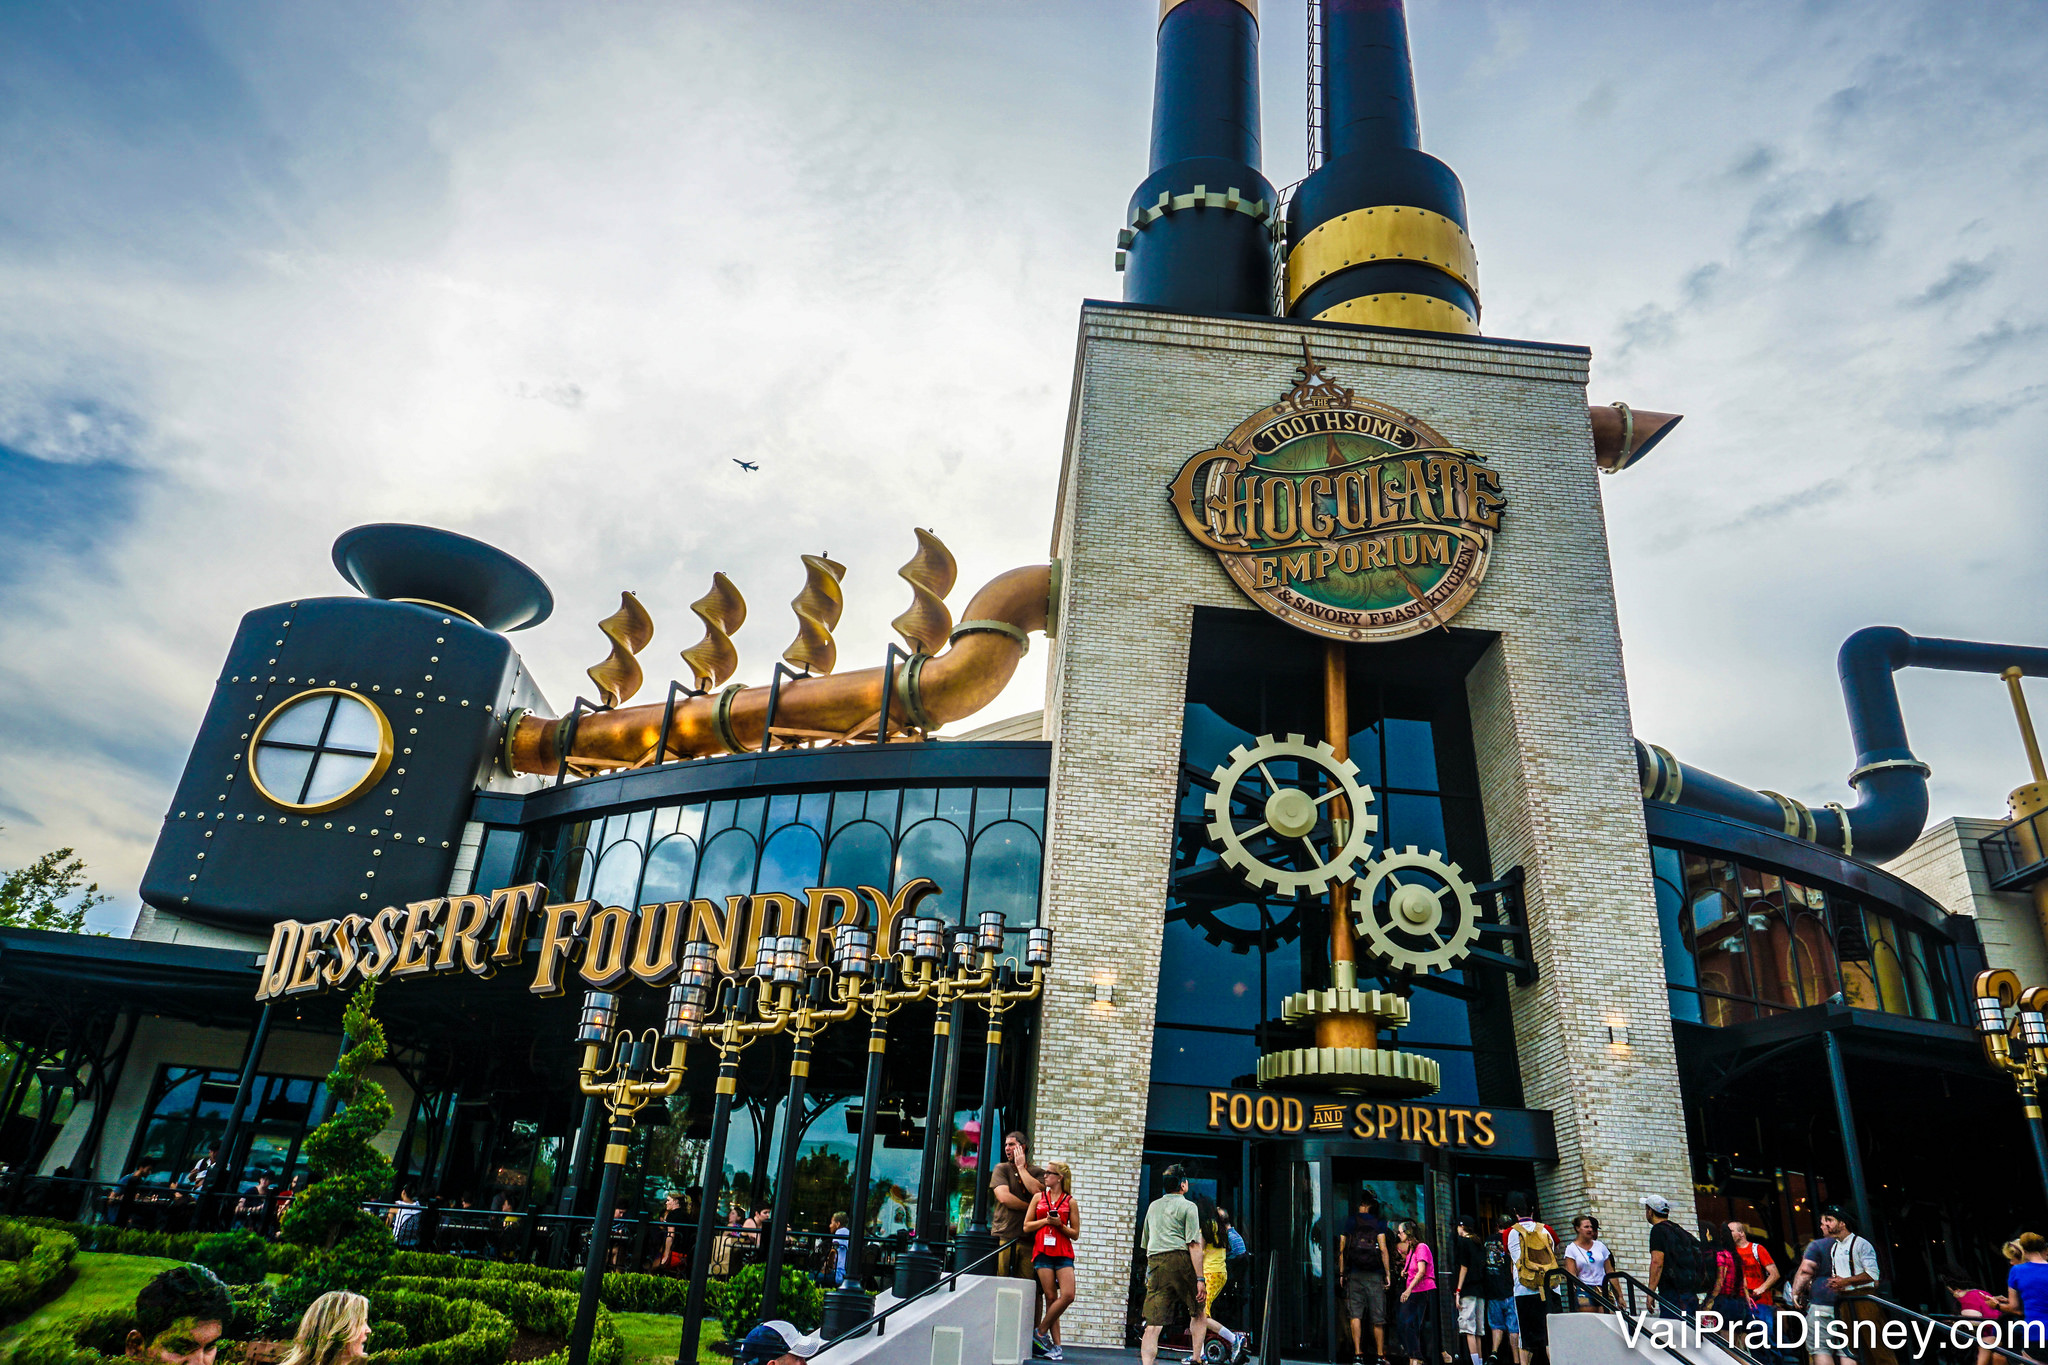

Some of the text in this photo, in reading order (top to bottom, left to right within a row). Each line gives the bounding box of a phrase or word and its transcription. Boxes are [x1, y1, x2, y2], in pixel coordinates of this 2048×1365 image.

[1261, 412, 1406, 446] TOOTHSOME
[1312, 399, 1329, 407] THE
[1167, 443, 1508, 553] CHOCOLATE
[1252, 534, 1452, 590] EMPORIUM
[1278, 545, 1475, 626] & SAVORY FEAST KITCHEN
[256, 877, 943, 1001] DESSERT FOUNDRY
[1208, 1091, 1496, 1147] FOOD AND SPIRITS
